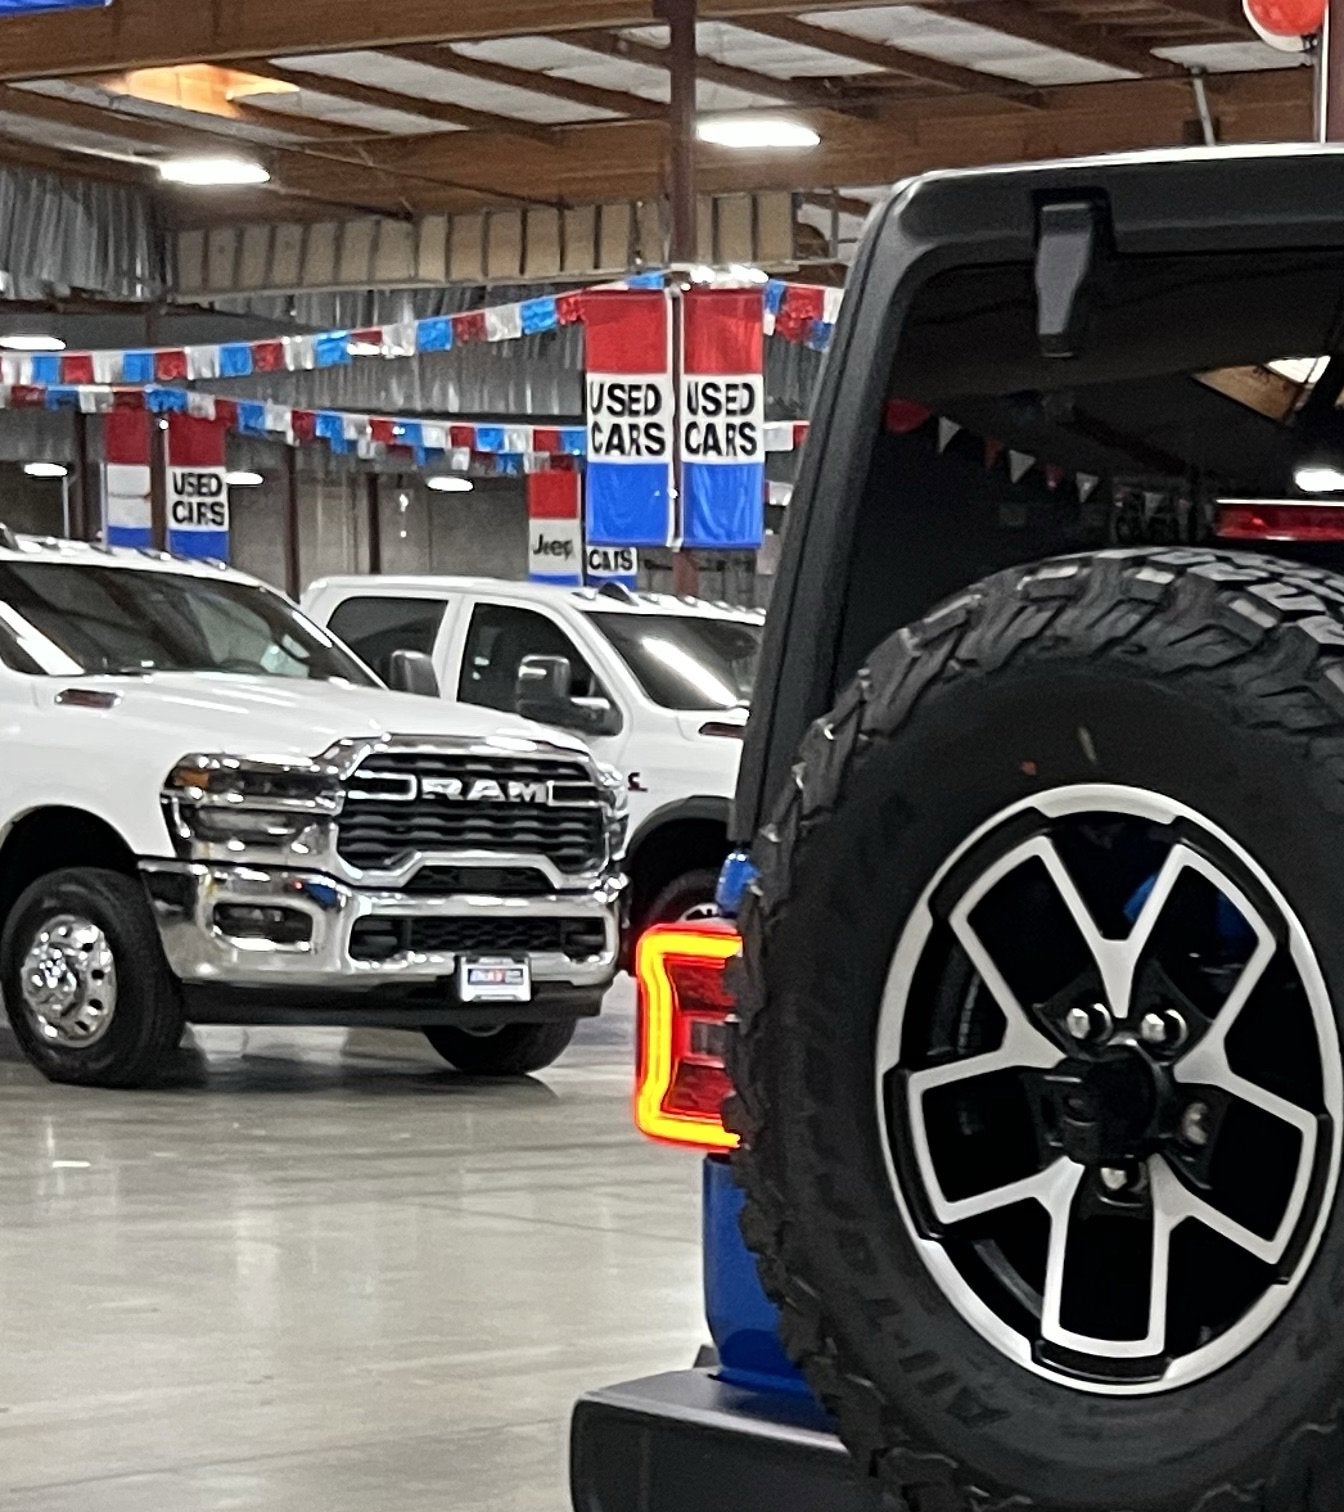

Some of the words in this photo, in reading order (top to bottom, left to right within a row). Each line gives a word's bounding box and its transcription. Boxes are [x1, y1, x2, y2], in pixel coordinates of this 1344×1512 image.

[589, 382, 663, 418] USED
[686, 381, 756, 417] USED
[590, 421, 667, 457] CARS
[684, 420, 758, 457] CARS
[171, 472, 223, 497] USED
[171, 500, 226, 526] CARS
[532, 534, 574, 561] Jeep
[588, 549, 633, 571] CARS
[420, 778, 548, 803] RAM
